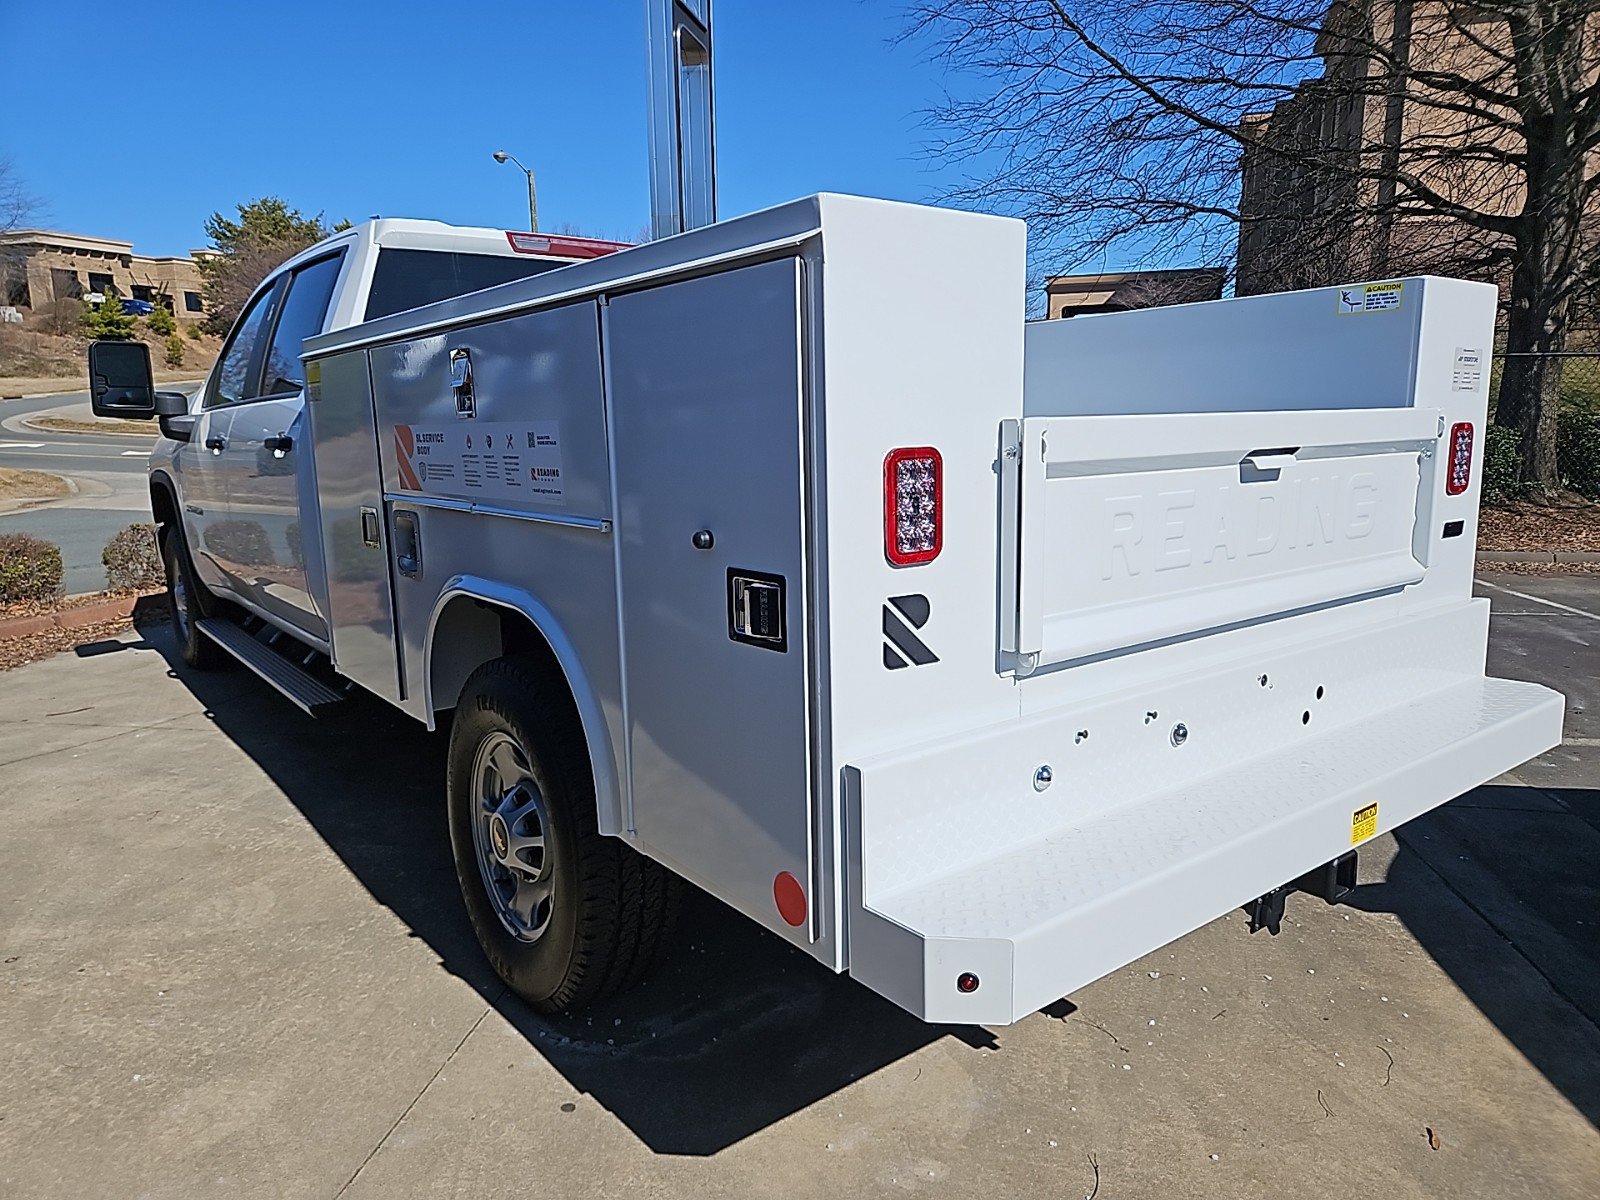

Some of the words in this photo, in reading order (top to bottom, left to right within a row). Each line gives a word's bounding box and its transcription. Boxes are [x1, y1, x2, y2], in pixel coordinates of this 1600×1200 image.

[1372, 283, 1402, 292] CAUTION
[423, 433, 444, 443] SERVICE
[417, 446, 431, 455] BODY
[537, 468, 560, 478] READING
[1100, 471, 1382, 582] READING
[1354, 804, 1377, 824] CAUTION
